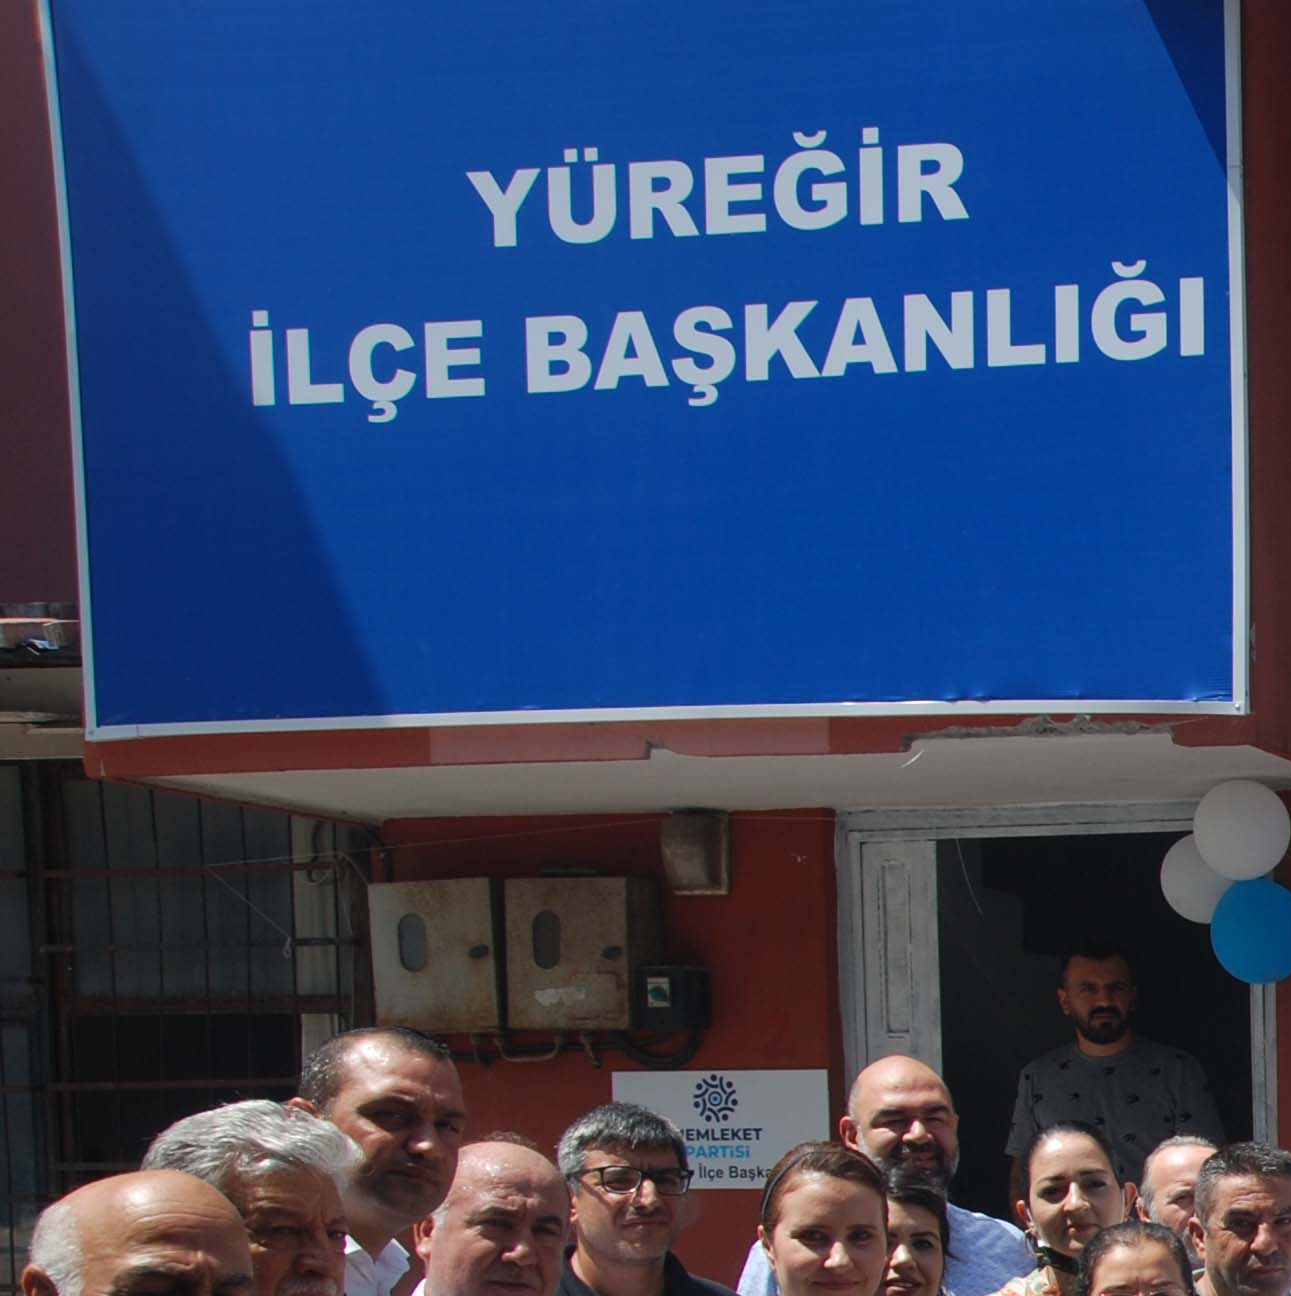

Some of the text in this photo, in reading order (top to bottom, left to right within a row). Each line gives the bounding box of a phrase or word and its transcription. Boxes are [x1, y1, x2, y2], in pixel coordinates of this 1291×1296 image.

[466, 127, 969, 247] YÜREĞİR
[249, 260, 1205, 423] İLÇE BAŞKANLIĞI
[681, 1128, 763, 1141] EMLEKET
